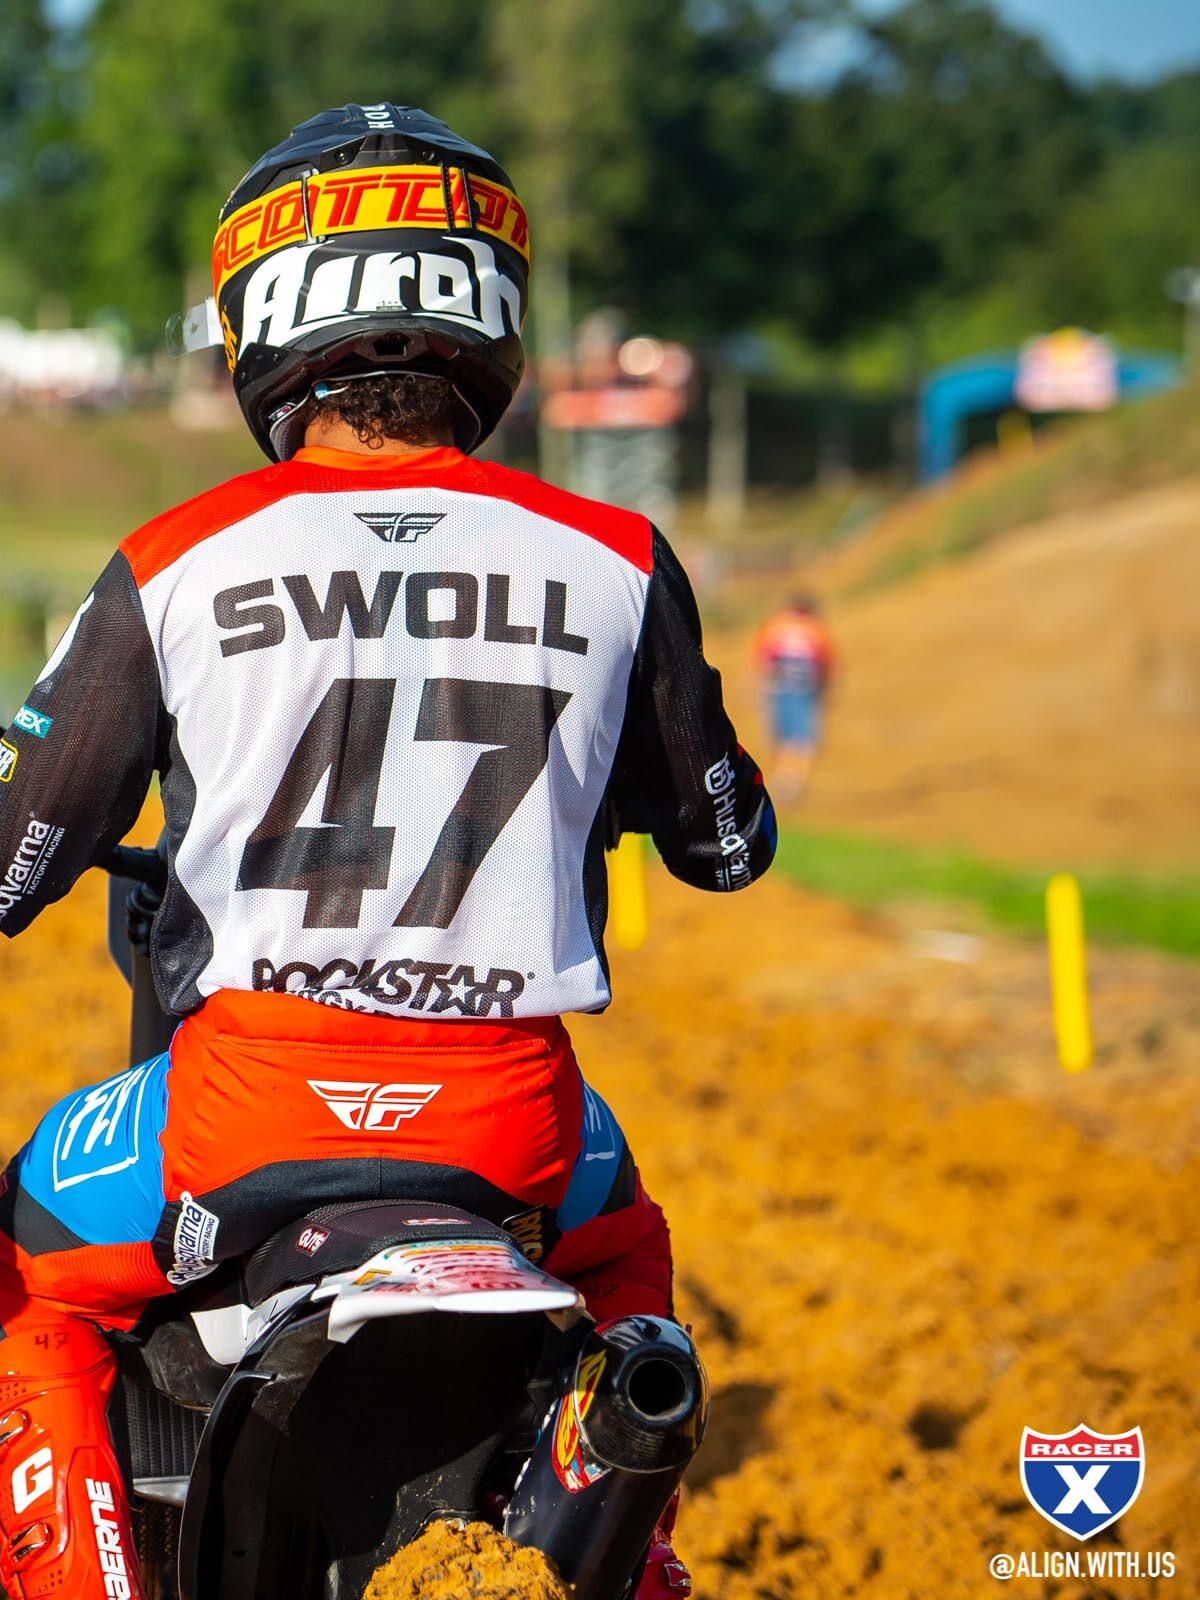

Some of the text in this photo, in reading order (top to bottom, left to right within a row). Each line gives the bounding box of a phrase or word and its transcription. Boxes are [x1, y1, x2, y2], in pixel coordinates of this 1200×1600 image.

[237, 236, 521, 361] Airoh
[213, 570, 589, 658] SWOLL
[234, 677, 573, 929] 47
[27, 827, 65, 895] FACTORY RACING
[203, 1217, 216, 1240] RACING
[34, 1332, 70, 1351] 47
